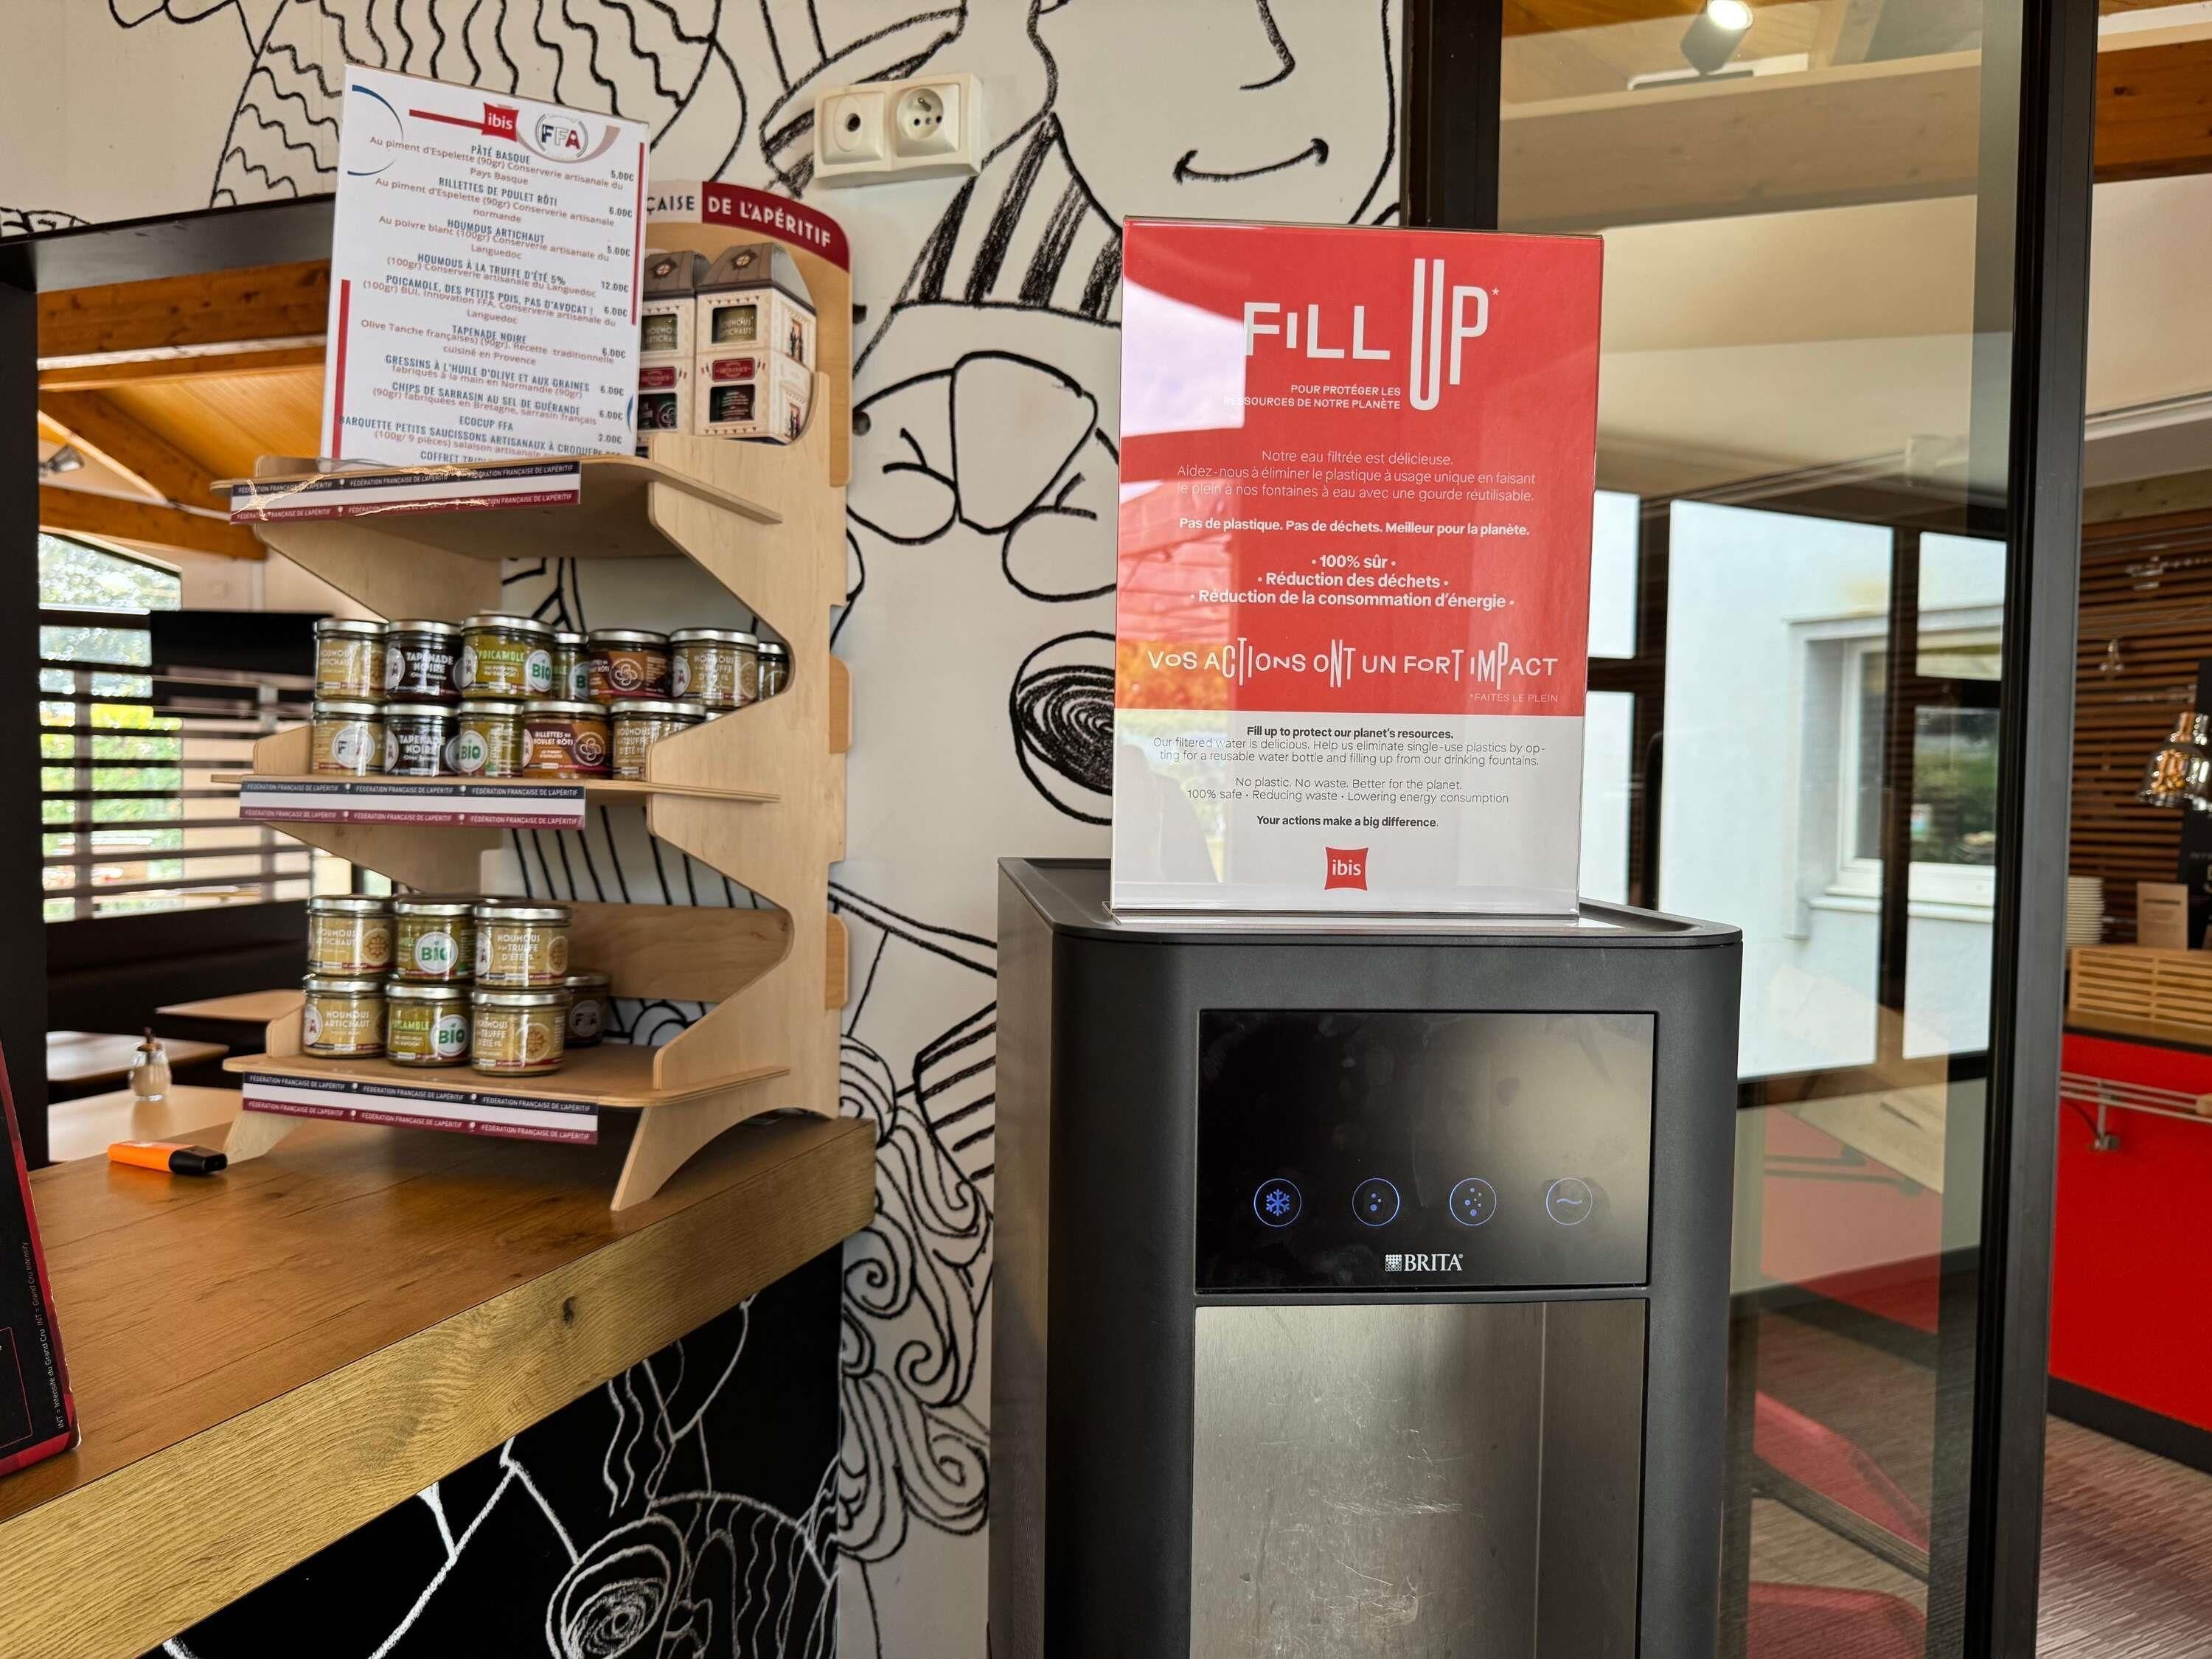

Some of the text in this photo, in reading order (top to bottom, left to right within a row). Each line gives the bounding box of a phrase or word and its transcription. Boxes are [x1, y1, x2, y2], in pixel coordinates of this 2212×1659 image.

[487, 112, 513, 131] ibis
[541, 124, 581, 150] FFA
[470, 145, 529, 164] PÂTÉ BASQUE
[438, 177, 557, 206] RILLETTES DE POULET RÔTI
[447, 219, 544, 243] HOUMOUS ARTICHAUT
[708, 197, 731, 215] DE
[740, 201, 831, 247] L'APÉRITIF
[417, 253, 566, 285] HOUMOUS À LA TRUFFE D'ÉTÉ 5%
[451, 324, 526, 344] TAPENADE NOIRE
[385, 355, 590, 392] GRESSINS À L'HUILE D'OLIVE ET AUX GRAINES
[391, 381, 580, 415] CHIPS DE SARRASIN AU SEL DE GUÉRANDE
[1291, 383, 1401, 397] POUR PROTÉGER LES
[1222, 395, 1401, 410] RESSOURCES DE NOTRE PLANÈTE
[459, 416, 513, 431] ECOCUP FFA
[394, 422, 426, 435] PETITS
[429, 427, 487, 442] SAUCISSONS
[490, 435, 546, 450] ARTISANAUX
[548, 441, 554, 451] À
[1262, 450, 1453, 465] Notre eau filtrée est délicieuse.
[1179, 517, 1529, 537] Pas de plastique. Pas de déchets. Meilleur pour la planète.
[1320, 554, 1388, 568] 100% sûr
[1266, 571, 1440, 588] Réduction des déchets
[1198, 588, 1506, 611] Réduction de la consommation d'énergie
[1204, 637, 1306, 686] ACTIONS
[1313, 639, 1356, 688] ONT
[1363, 655, 1396, 673] UN
[1404, 650, 1464, 681] FORT
[1470, 642, 1558, 690] IMPACT
[1512, 693, 1524, 702] LE
[1528, 692, 1557, 703] PLEIN
[1247, 726, 1453, 740] Fill up to protect our planet's resources.
[1234, 776, 1462, 791] No plastic. No waste. Better for the planet.
[1256, 815, 1280, 824] Your
[1281, 815, 1321, 825] actions
[1323, 815, 1352, 826] make
[1363, 816, 1380, 829] big
[1381, 816, 1438, 827] difference.
[1332, 860, 1362, 878] ibis
[439, 1029, 465, 1044] BIO
